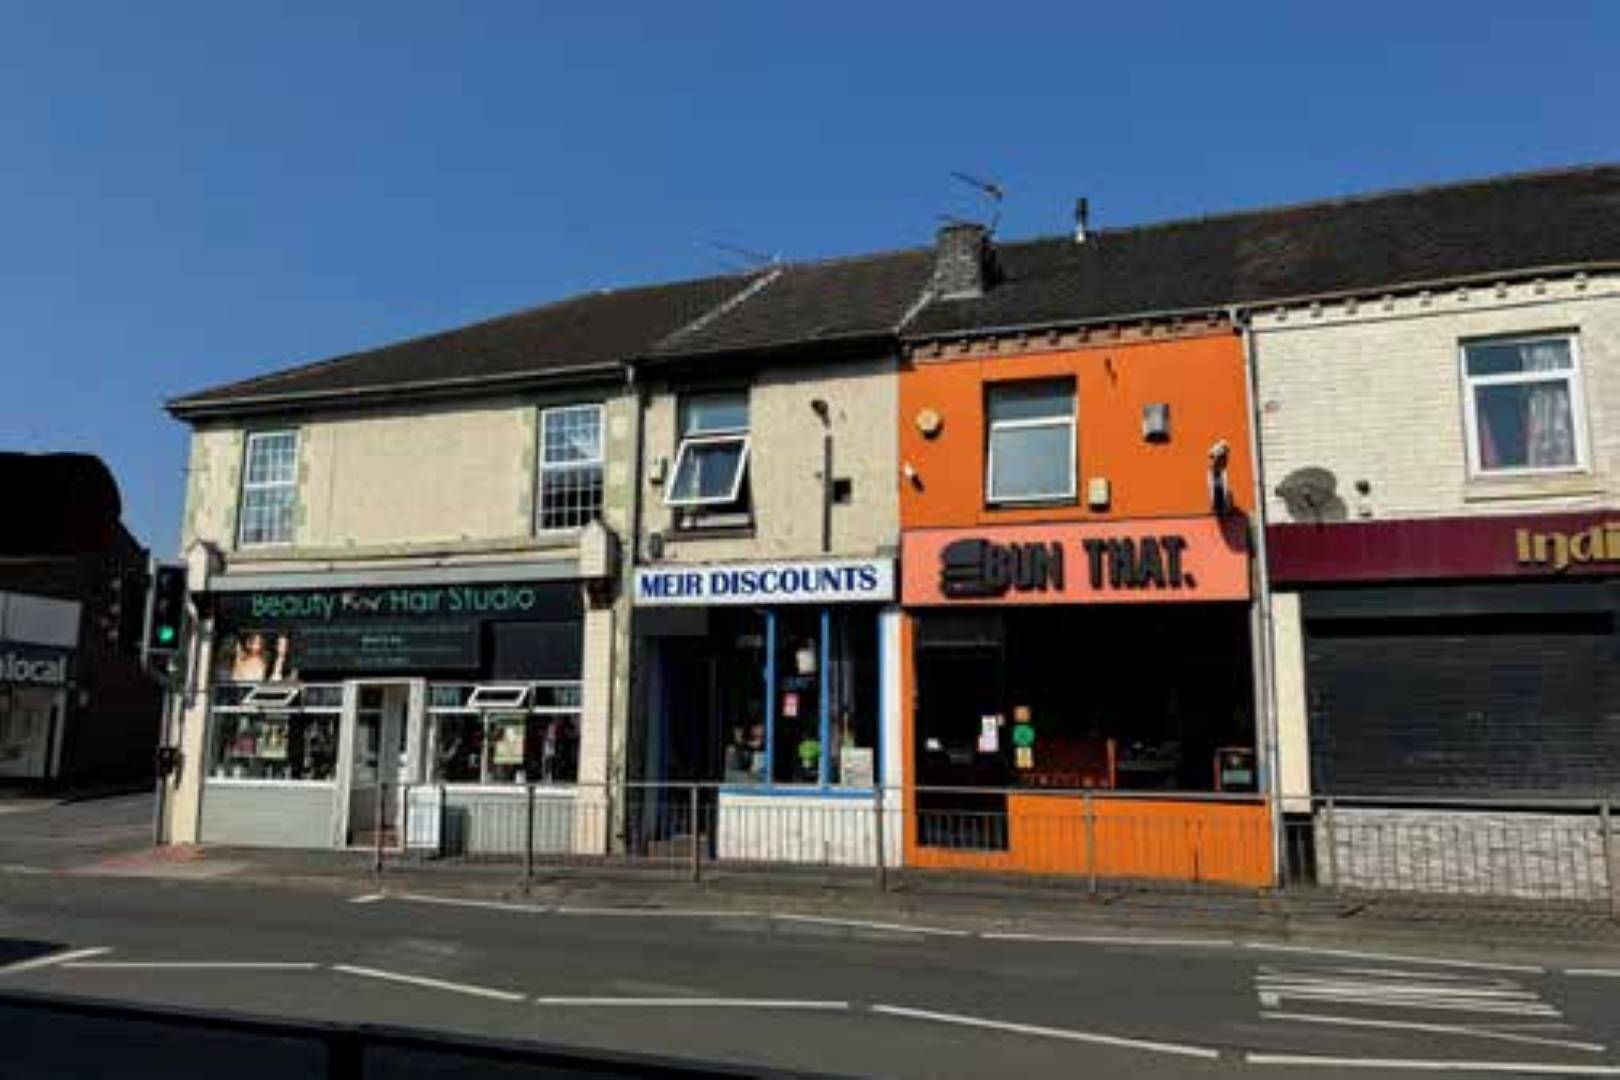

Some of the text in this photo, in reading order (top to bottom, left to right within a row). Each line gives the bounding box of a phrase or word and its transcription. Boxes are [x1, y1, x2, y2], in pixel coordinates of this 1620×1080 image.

[641, 565, 877, 597] MEIR DISCOUNTS
[1083, 535, 1197, 590] THAT.
[251, 592, 334, 621] Beauty
[391, 588, 441, 610] Hair
[448, 584, 536, 610] Studio
